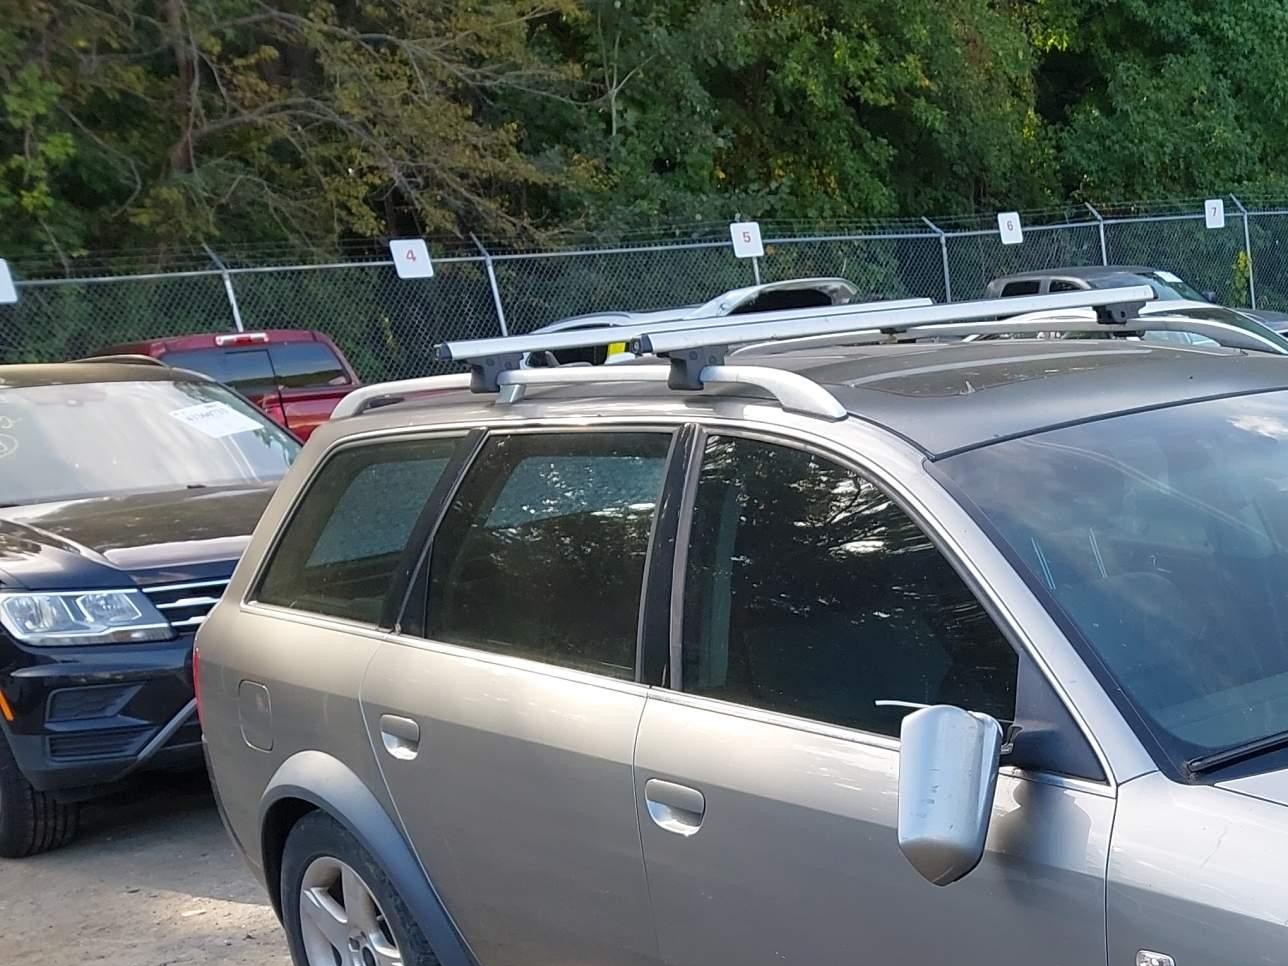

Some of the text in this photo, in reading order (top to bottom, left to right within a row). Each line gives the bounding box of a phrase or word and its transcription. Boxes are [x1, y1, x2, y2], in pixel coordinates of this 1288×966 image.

[1211, 206, 1217, 217] 7
[1006, 220, 1014, 231] 6
[742, 231, 752, 243] 5
[406, 249, 416, 262] 4
